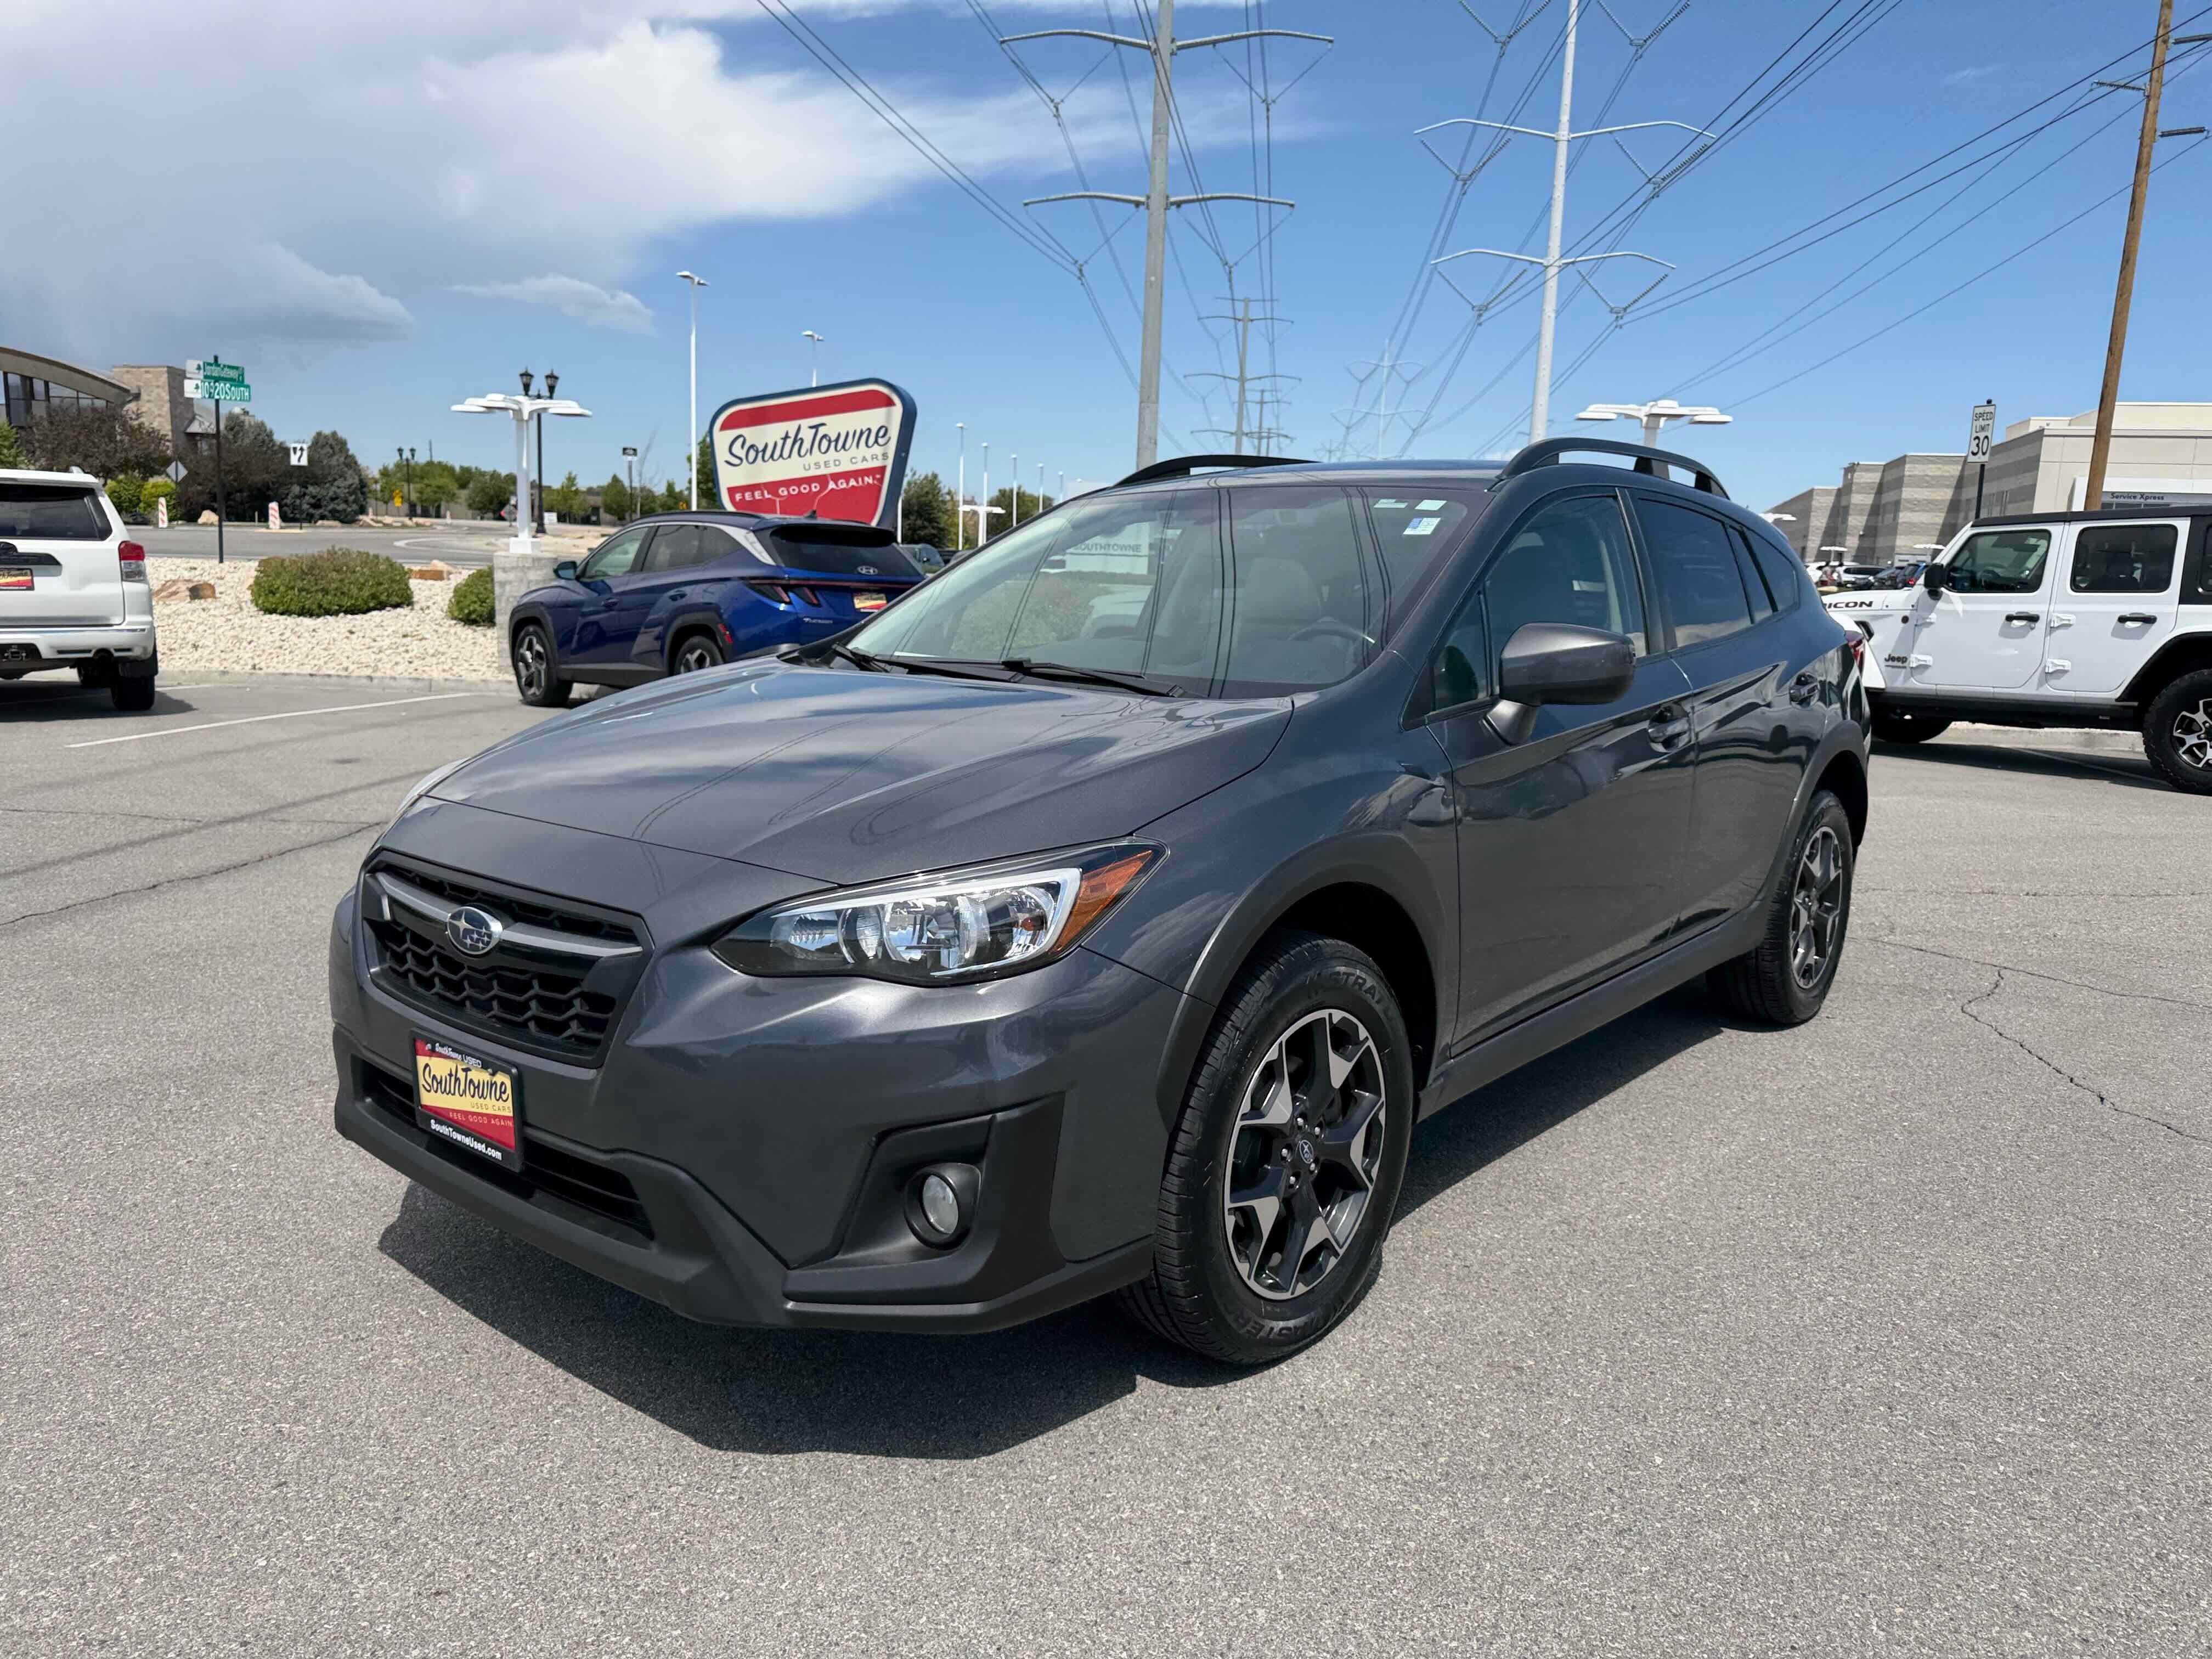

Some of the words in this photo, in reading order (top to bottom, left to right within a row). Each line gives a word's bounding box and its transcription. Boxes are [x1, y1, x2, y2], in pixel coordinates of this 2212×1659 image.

[1974, 411, 1993, 421] SPEED
[1975, 424, 1990, 433] LIMIT
[724, 422, 891, 467] SouthTowne
[1971, 435, 1989, 456] 30
[803, 459, 842, 472] USED
[850, 452, 889, 465] CARS
[735, 490, 772, 502] FEEL
[778, 483, 821, 496] GOOD
[1823, 601, 1874, 609] ICON
[1884, 653, 1908, 664] Jeep
[462, 1053, 482, 1068] USED
[422, 1063, 509, 1102] SouthTowne
[470, 1102, 489, 1110] USED
[492, 1104, 511, 1114] CARS
[449, 1111, 466, 1121] FEEL
[469, 1115, 488, 1124] GOOD
[430, 1119, 502, 1161] SouthTowneUsed.com
